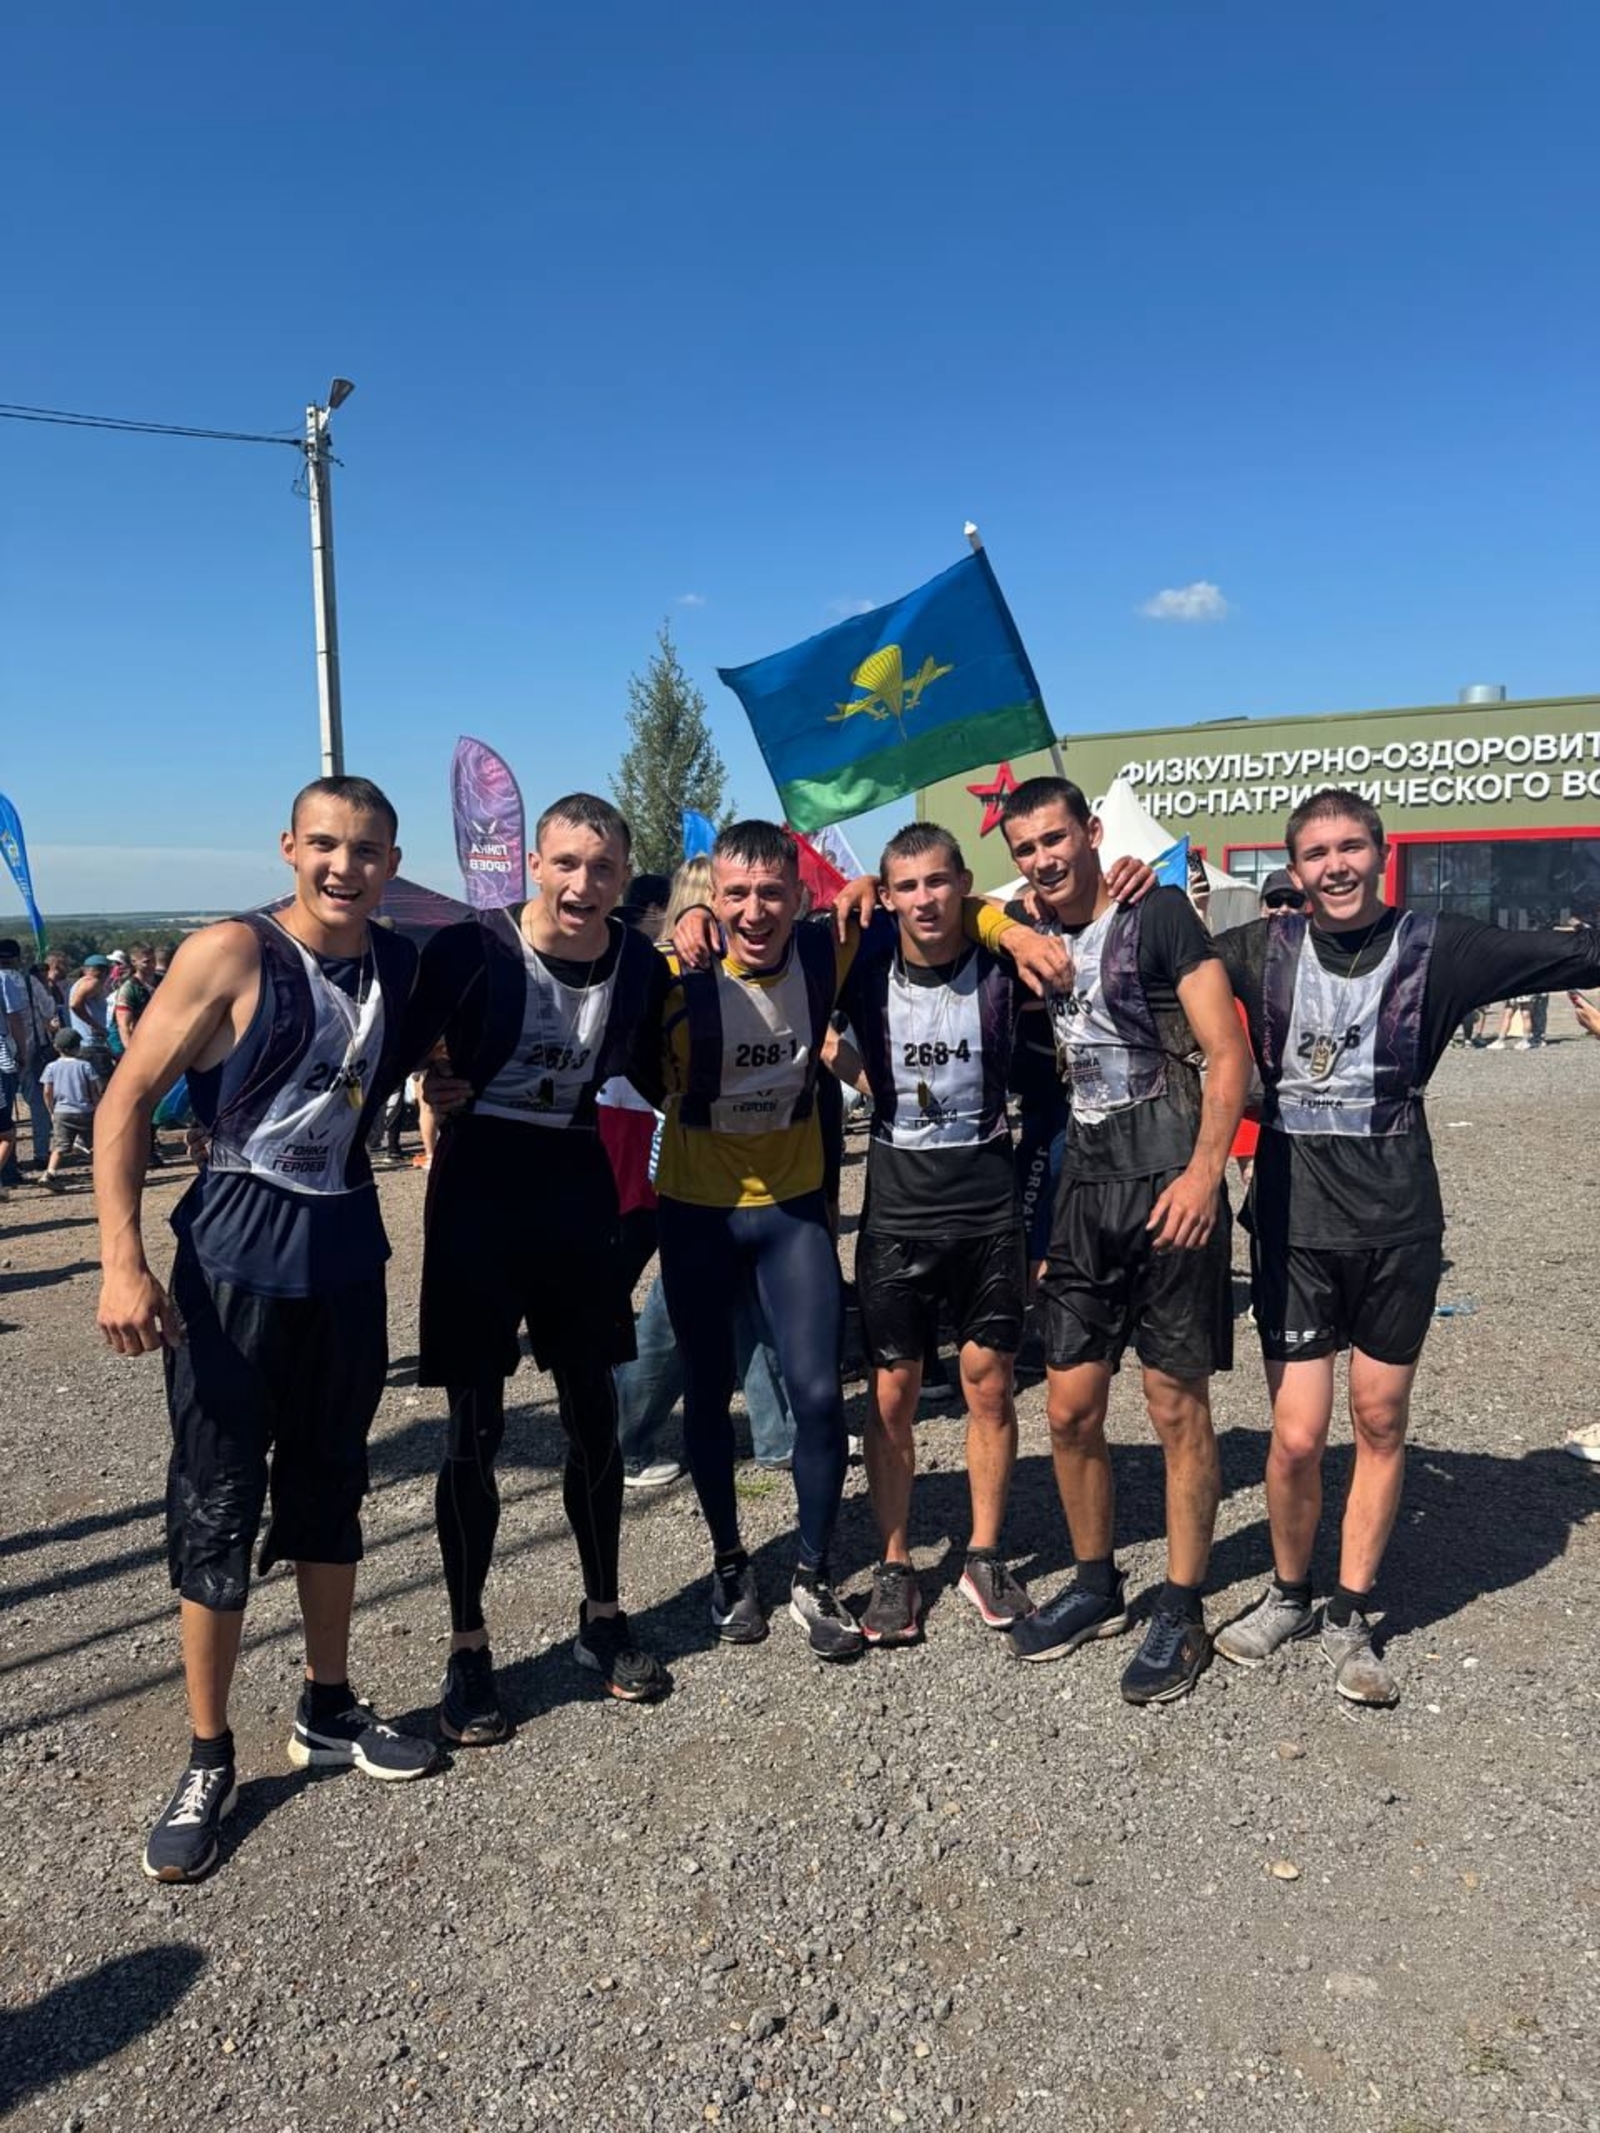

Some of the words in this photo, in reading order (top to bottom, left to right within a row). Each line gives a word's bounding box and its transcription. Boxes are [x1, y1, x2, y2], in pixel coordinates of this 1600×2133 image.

[735, 1038, 798, 1068] 268-1
[903, 1038, 971, 1068] 268-4
[1297, 1024, 1362, 1060] 2-6
[272, 1159, 327, 1173] ГЕРОЕВ
